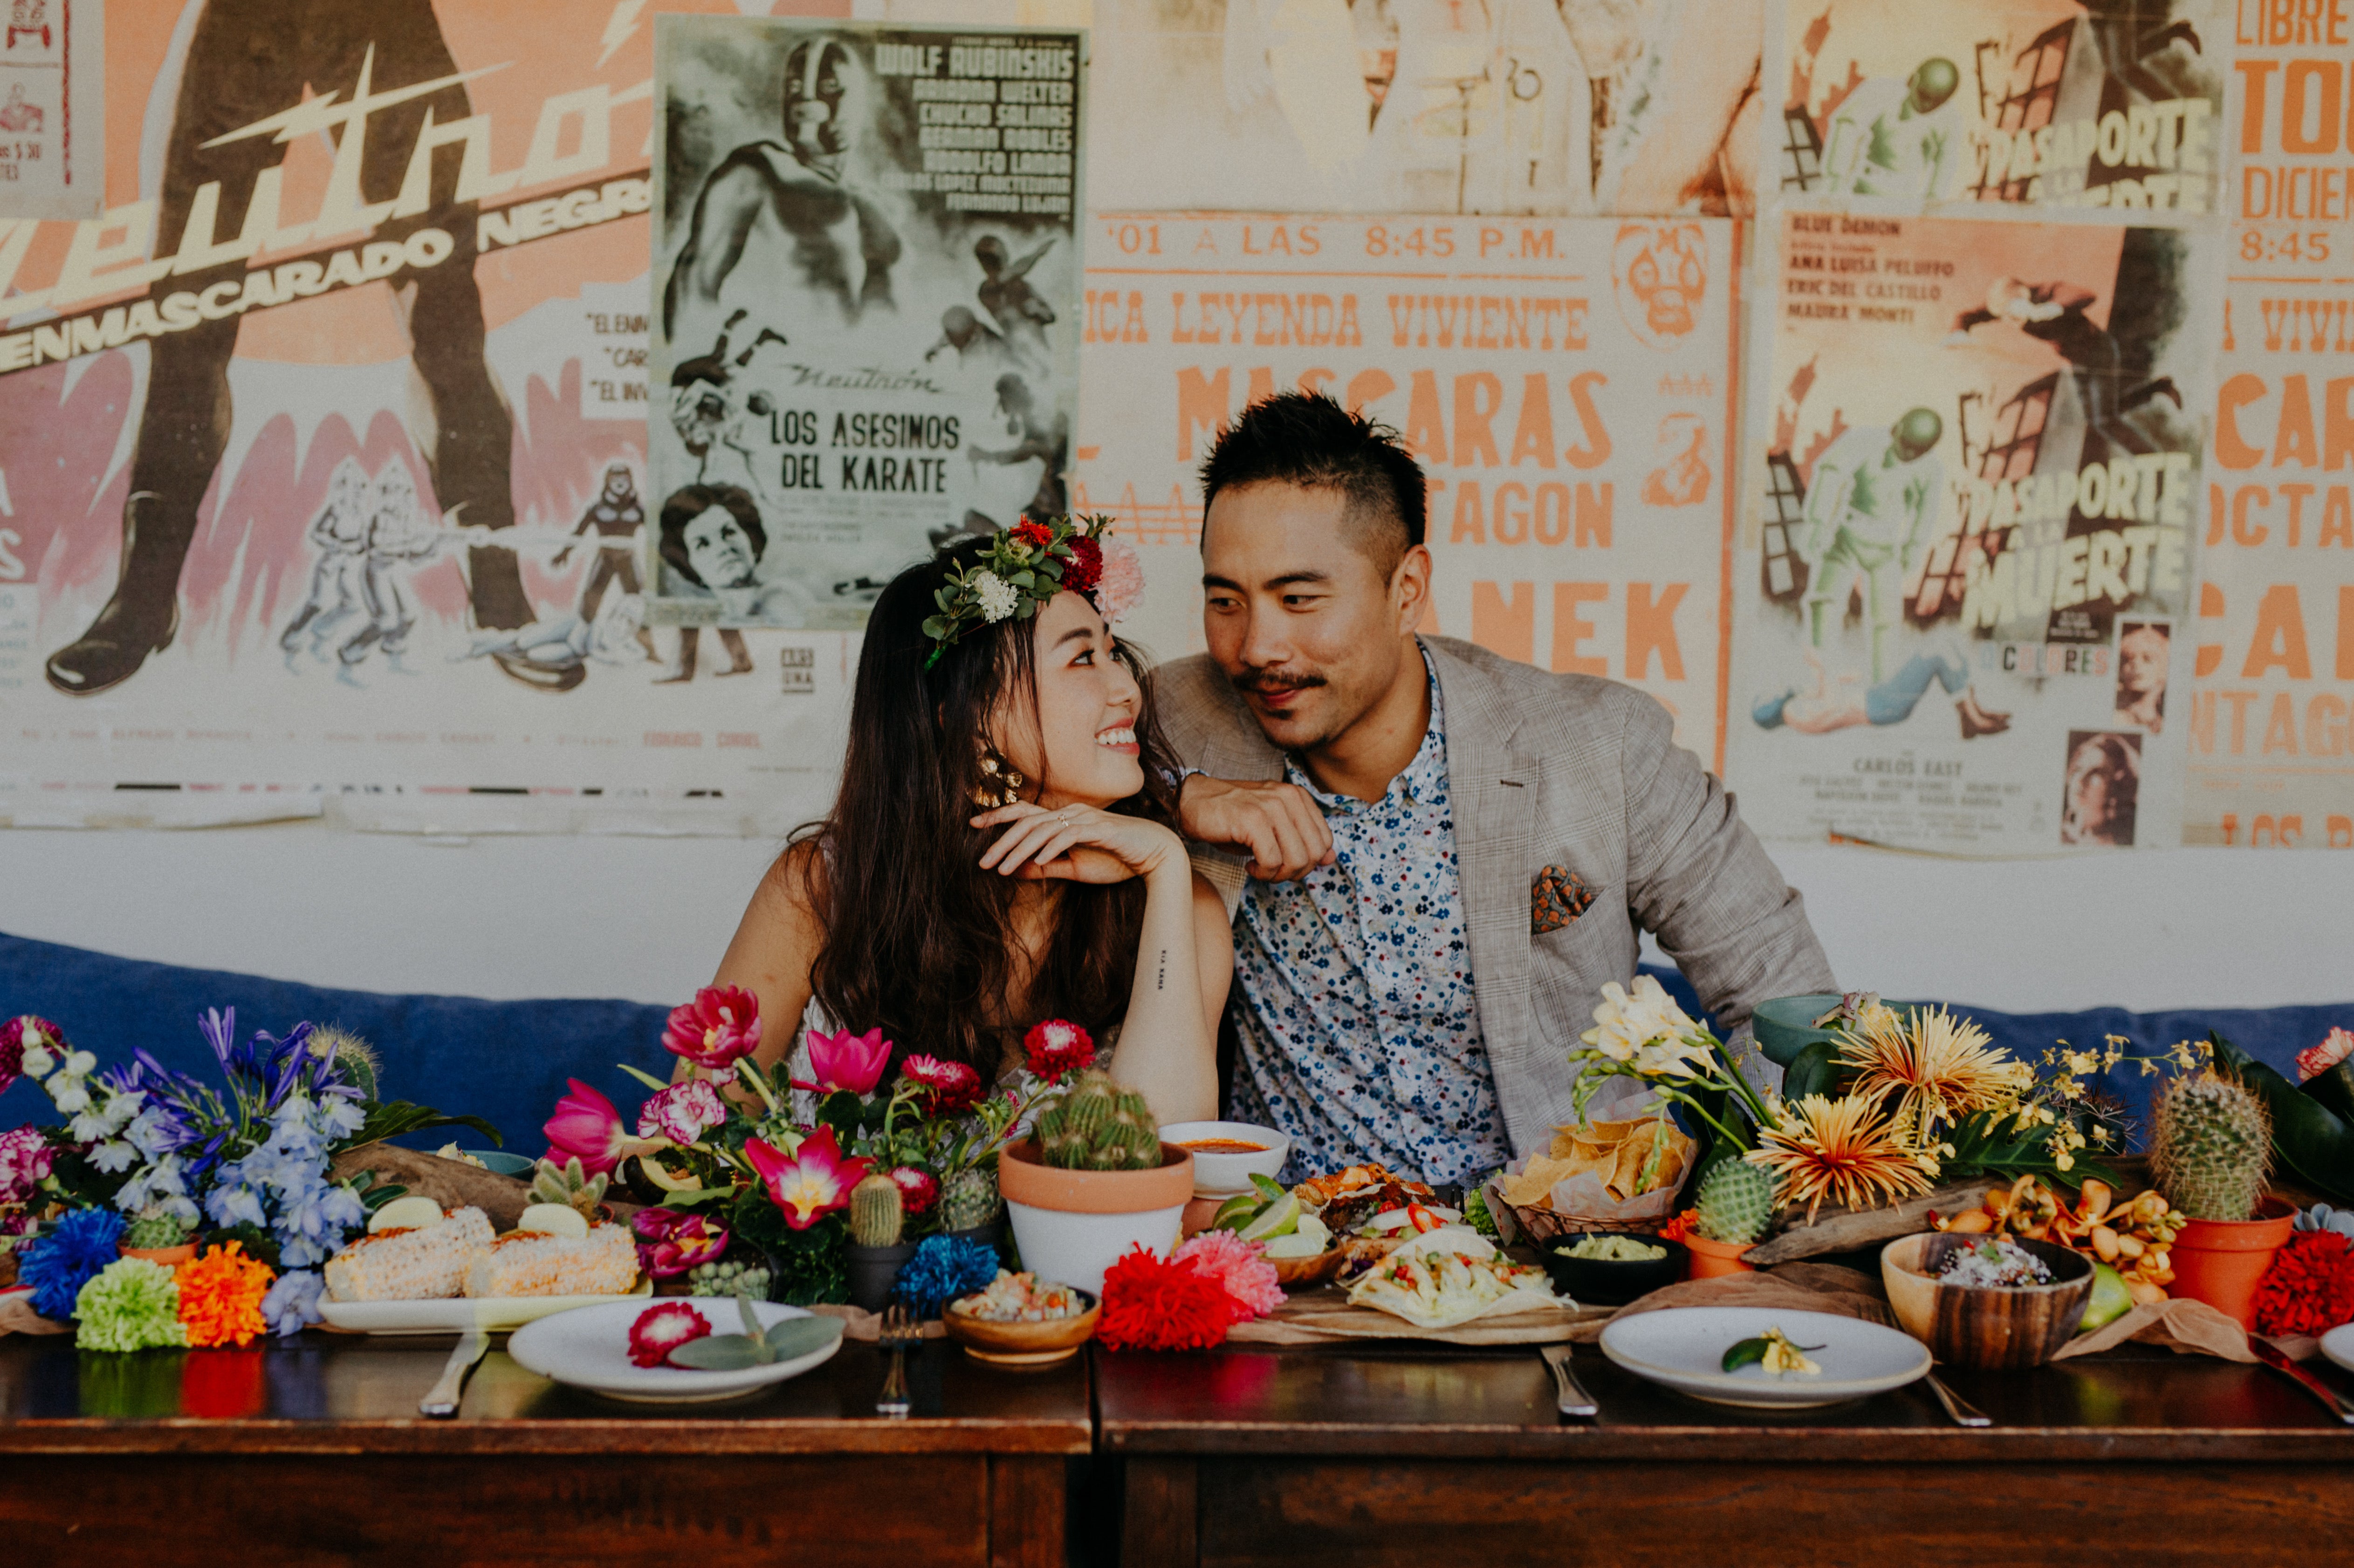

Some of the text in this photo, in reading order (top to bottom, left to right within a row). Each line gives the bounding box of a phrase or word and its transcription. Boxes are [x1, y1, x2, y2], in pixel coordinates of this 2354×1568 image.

[874, 44, 1074, 79] WOLF RUBINSKIS
[2235, 60, 2354, 154] TO
[1242, 226, 1321, 256] LAS
[1365, 226, 1455, 258] 8:45
[1479, 228, 1565, 259] P.M.
[1792, 215, 1902, 236] BLUE DEMON
[2240, 229, 2330, 262] 8:45
[1790, 254, 1955, 278] ANA LUISA PELUFFO
[1829, 281, 1856, 297] DEL
[1865, 283, 1942, 301] CASTILLO
[1171, 291, 1362, 347] LEYENDA
[1387, 294, 1588, 350] VIVIENTE
[770, 410, 961, 451] LOS ASESINOS
[782, 453, 947, 493] DEL KARATE
[1968, 452, 2193, 536] PASAPORTE
[1961, 527, 2186, 630] MUERTE
[1853, 756, 1915, 775] CARLOS
